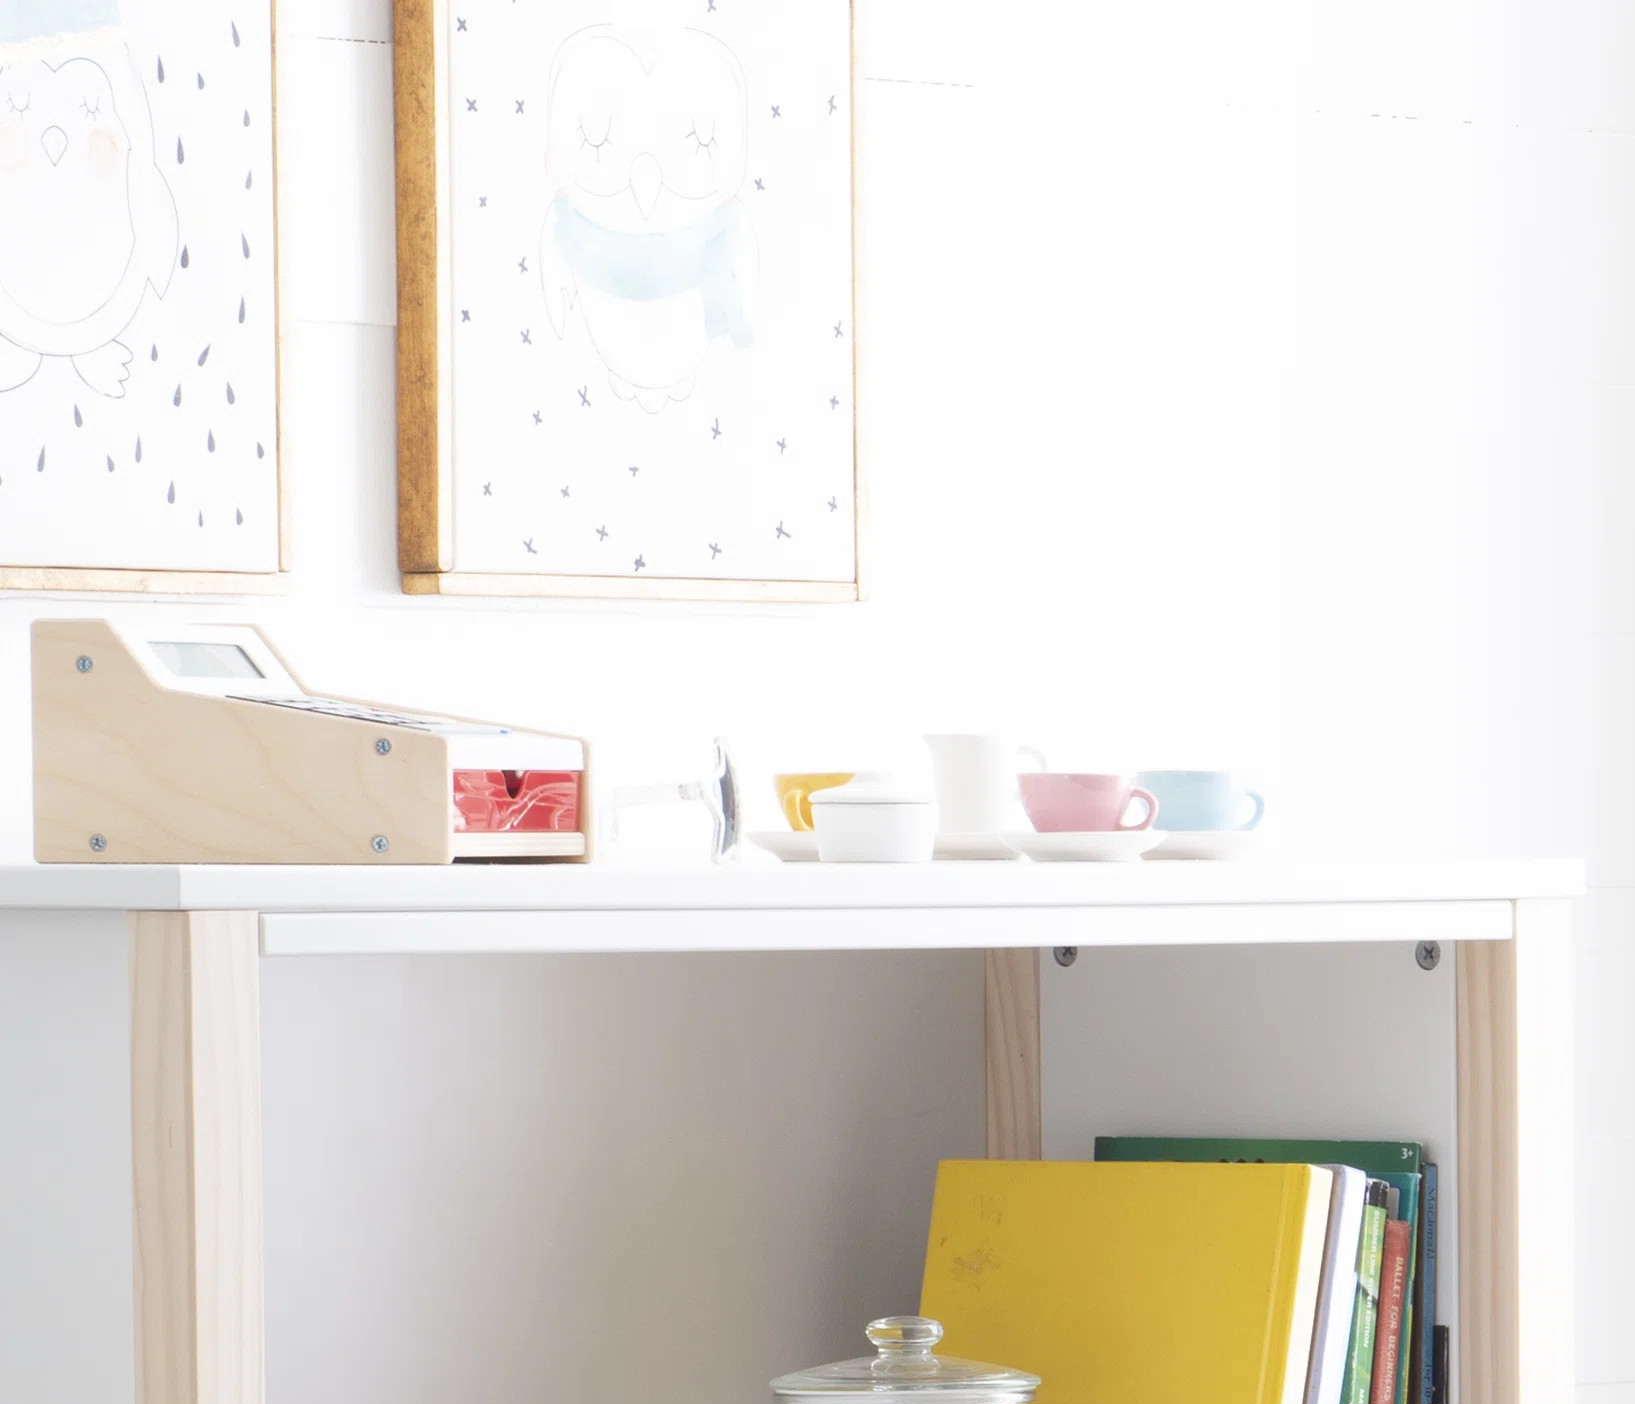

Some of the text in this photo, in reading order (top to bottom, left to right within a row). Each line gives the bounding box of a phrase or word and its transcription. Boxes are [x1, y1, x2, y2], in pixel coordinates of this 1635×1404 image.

[1401, 1147, 1414, 1160] 3+
[1371, 1210, 1380, 1252] SUMMER
[1393, 1256, 1405, 1299] BALLET
[1363, 1309, 1372, 1348] EDITION
[1389, 1306, 1399, 1329] FOR
[1384, 1335, 1396, 1401] BEGINNERS
